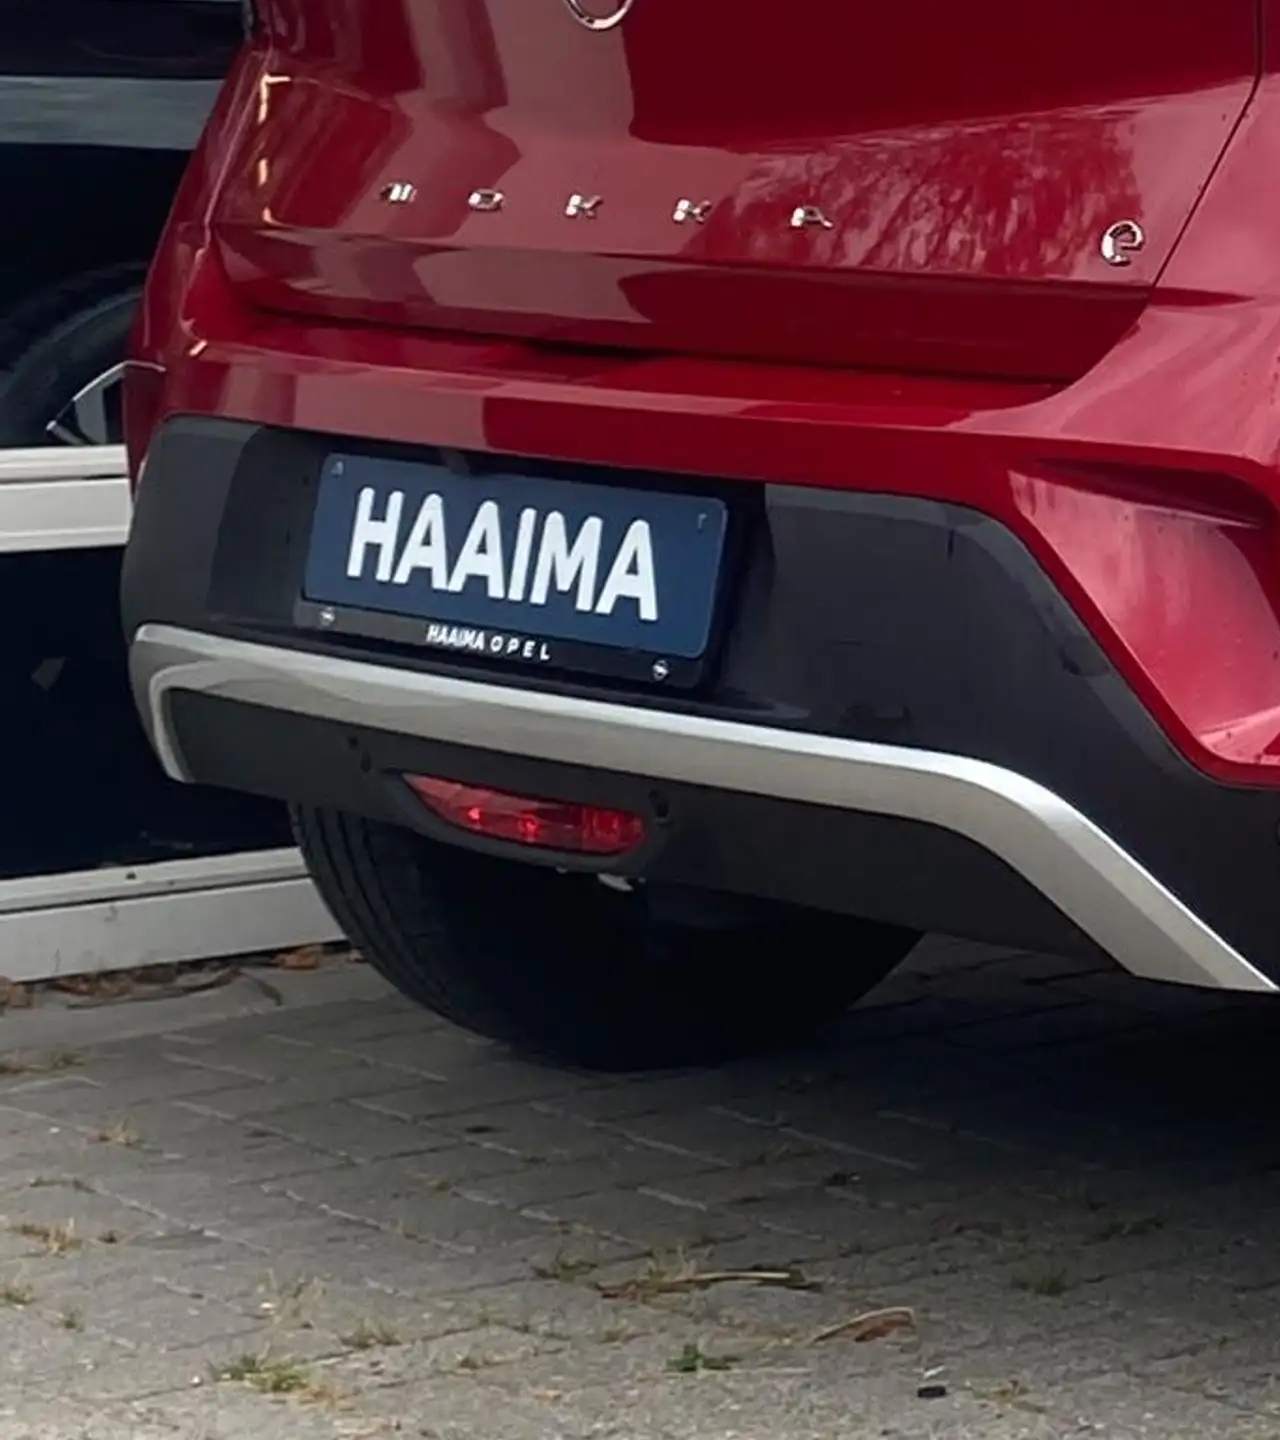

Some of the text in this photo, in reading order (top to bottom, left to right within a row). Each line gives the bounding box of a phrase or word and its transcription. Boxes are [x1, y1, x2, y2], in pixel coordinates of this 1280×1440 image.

[346, 485, 659, 621] HAAIMA
[426, 624, 551, 661] HAAIMA OPEL
